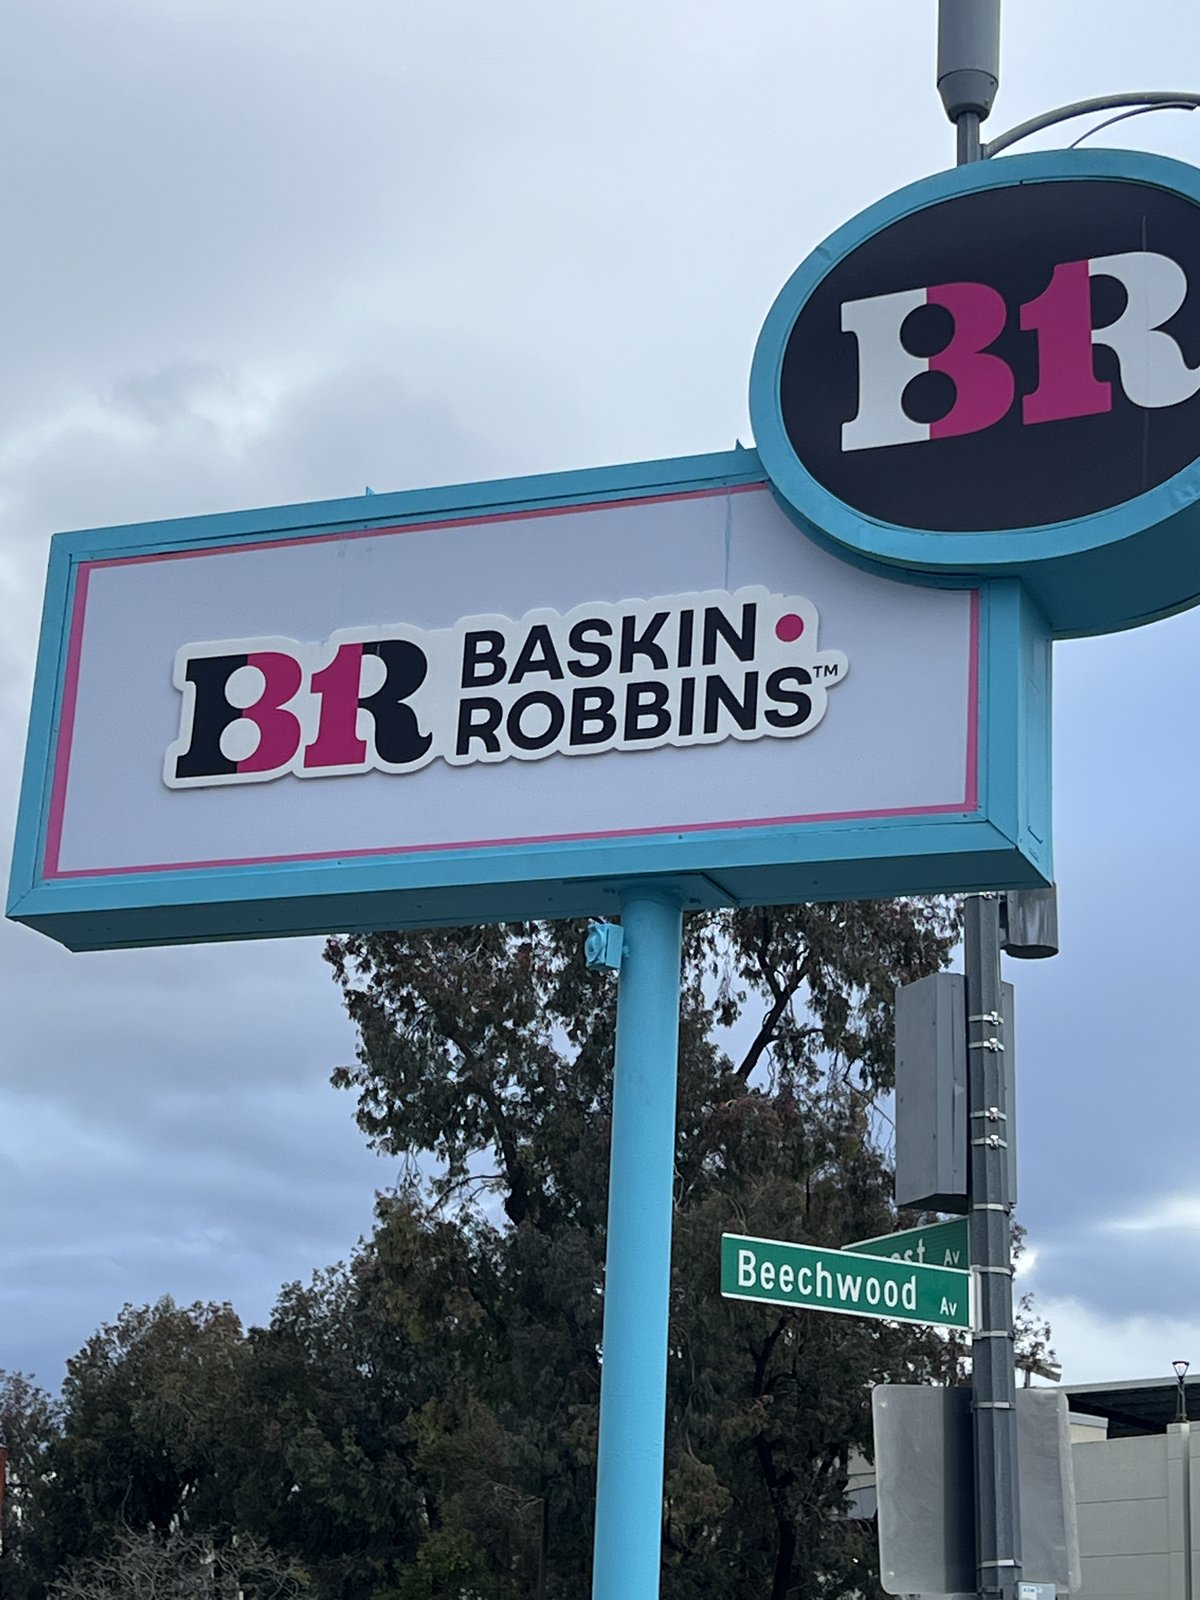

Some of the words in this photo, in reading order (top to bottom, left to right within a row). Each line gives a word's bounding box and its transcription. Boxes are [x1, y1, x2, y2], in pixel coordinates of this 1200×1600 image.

[460, 603, 757, 688] BASKIN
[175, 639, 433, 779] BR
[455, 666, 813, 756] ROBBINS
[737, 1249, 917, 1311] Beechwood
[939, 1296, 957, 1317] Av
[944, 1248, 960, 1267] Av
